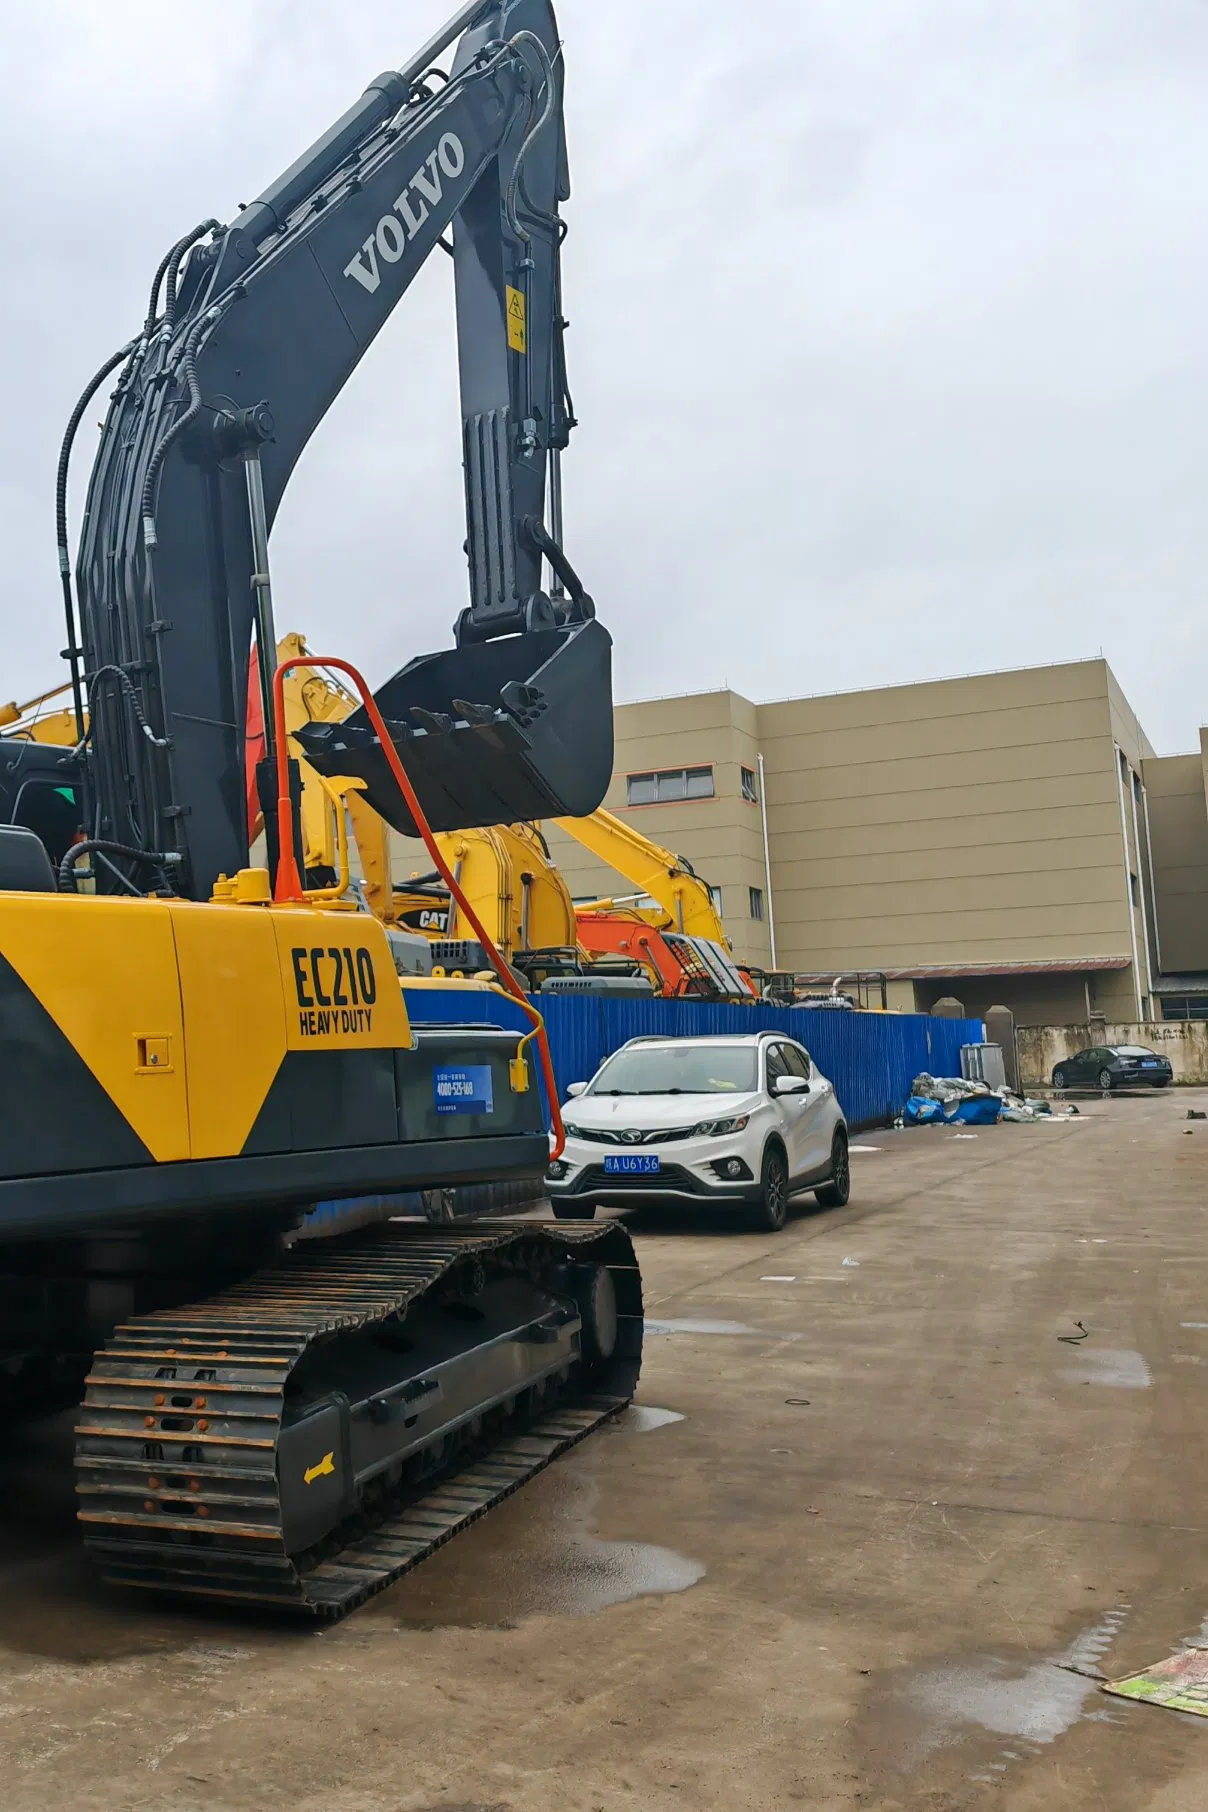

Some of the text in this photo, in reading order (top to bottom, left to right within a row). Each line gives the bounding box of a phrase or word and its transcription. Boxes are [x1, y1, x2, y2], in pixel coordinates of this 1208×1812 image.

[343, 132, 464, 294] VOLVO
[419, 910, 448, 931] CAT
[291, 947, 376, 1007] EC210
[299, 1008, 372, 1036] HEAVY DUTY
